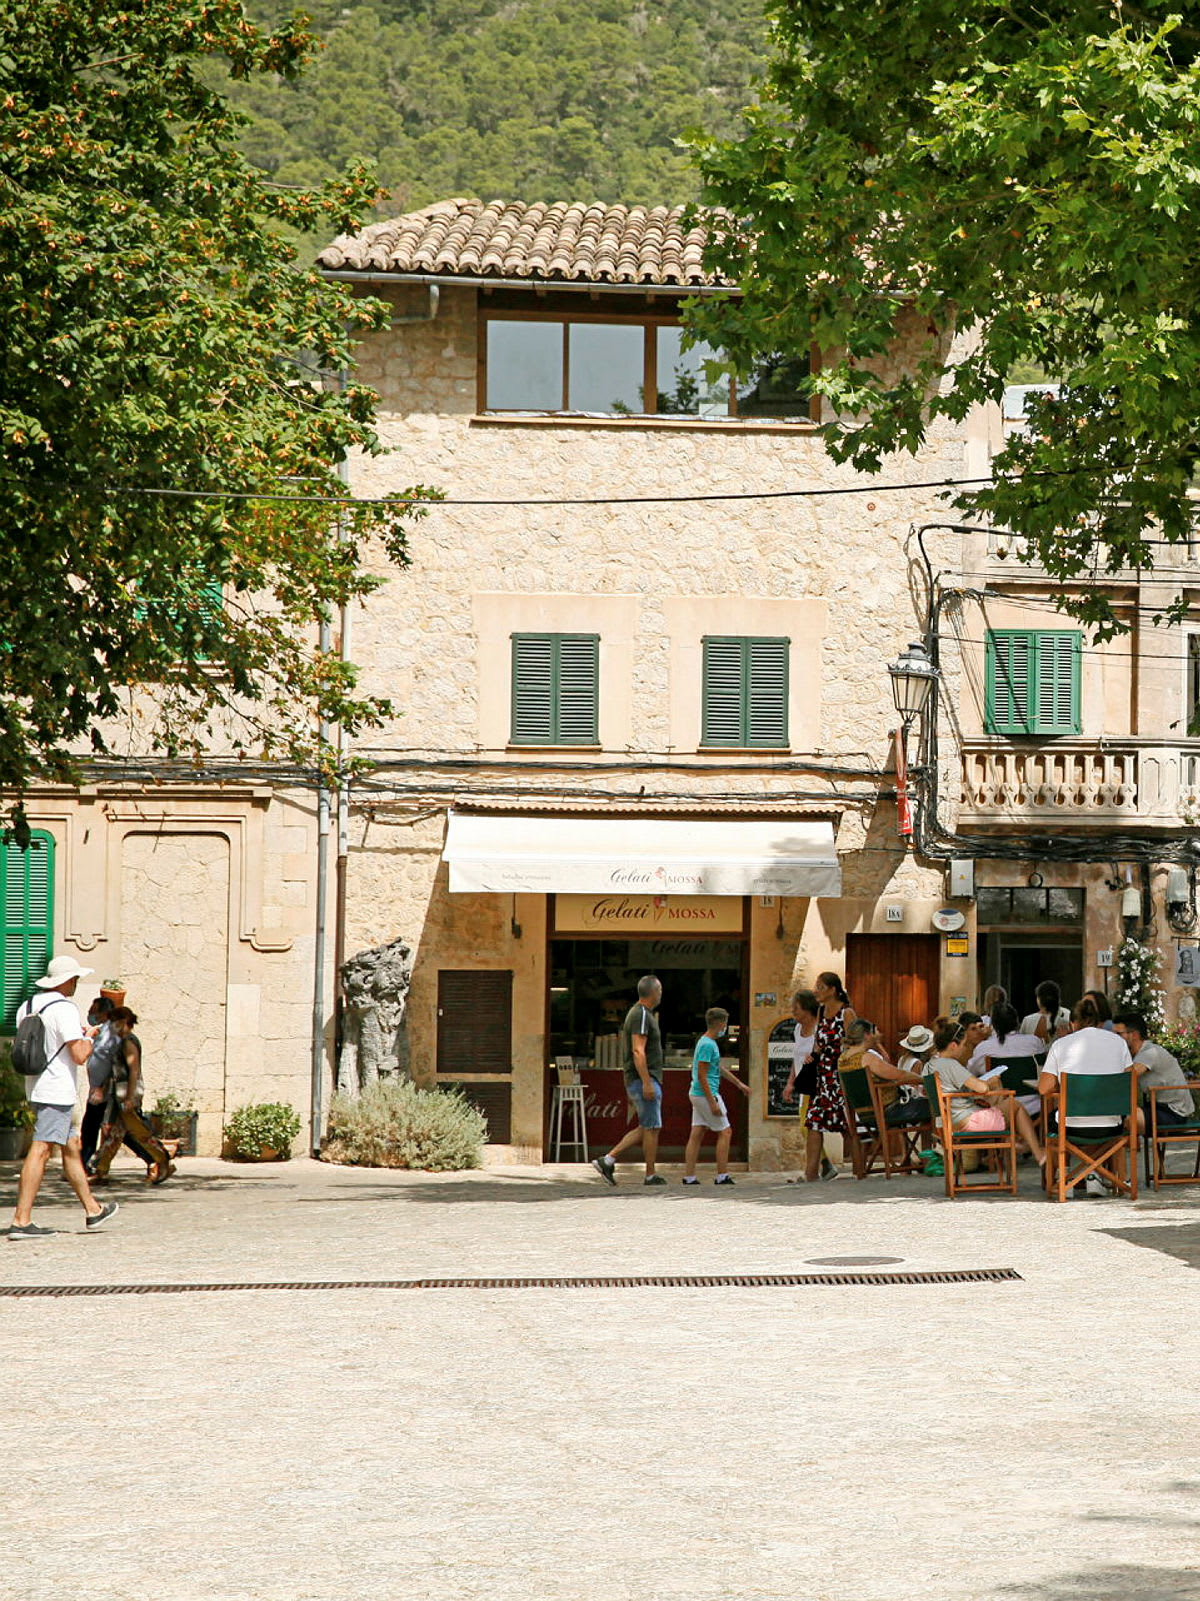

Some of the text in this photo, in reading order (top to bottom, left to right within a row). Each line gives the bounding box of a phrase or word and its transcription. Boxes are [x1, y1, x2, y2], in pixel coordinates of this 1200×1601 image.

[609, 867, 703, 884] Gelati MOSSA
[591, 898, 716, 920] Gelati MOSSA
